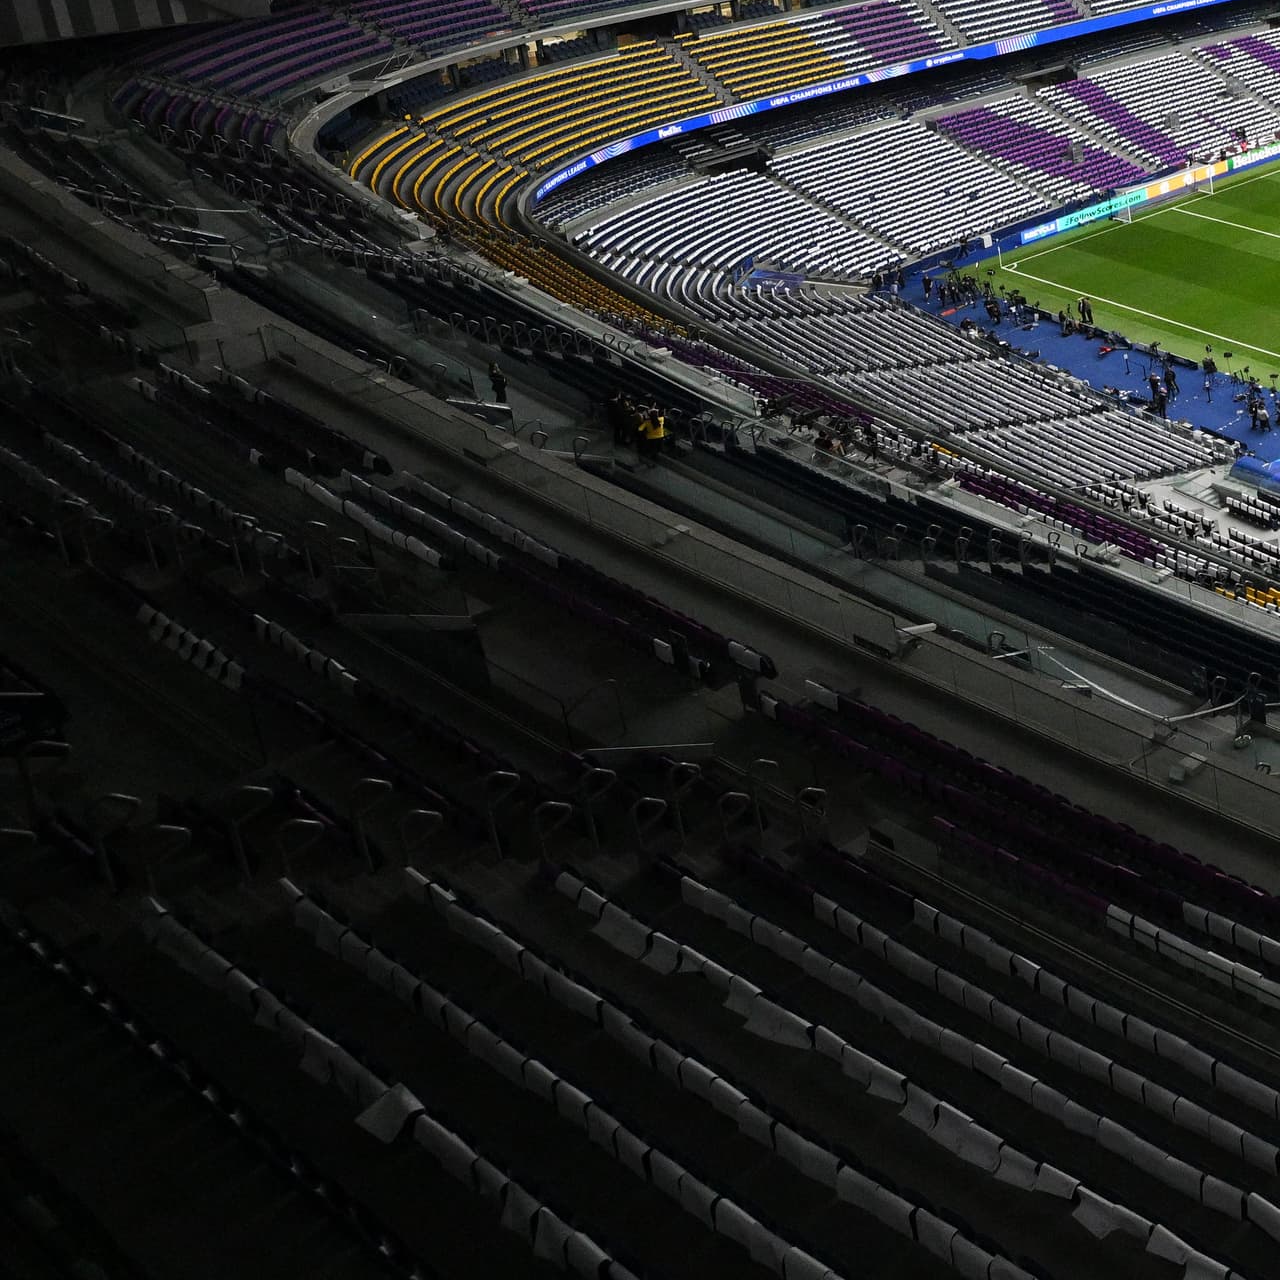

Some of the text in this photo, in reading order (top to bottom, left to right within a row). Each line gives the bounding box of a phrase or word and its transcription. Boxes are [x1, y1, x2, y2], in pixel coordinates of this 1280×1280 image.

[770, 78, 860, 107] UEFA CHAMPIONS LEAGUE
